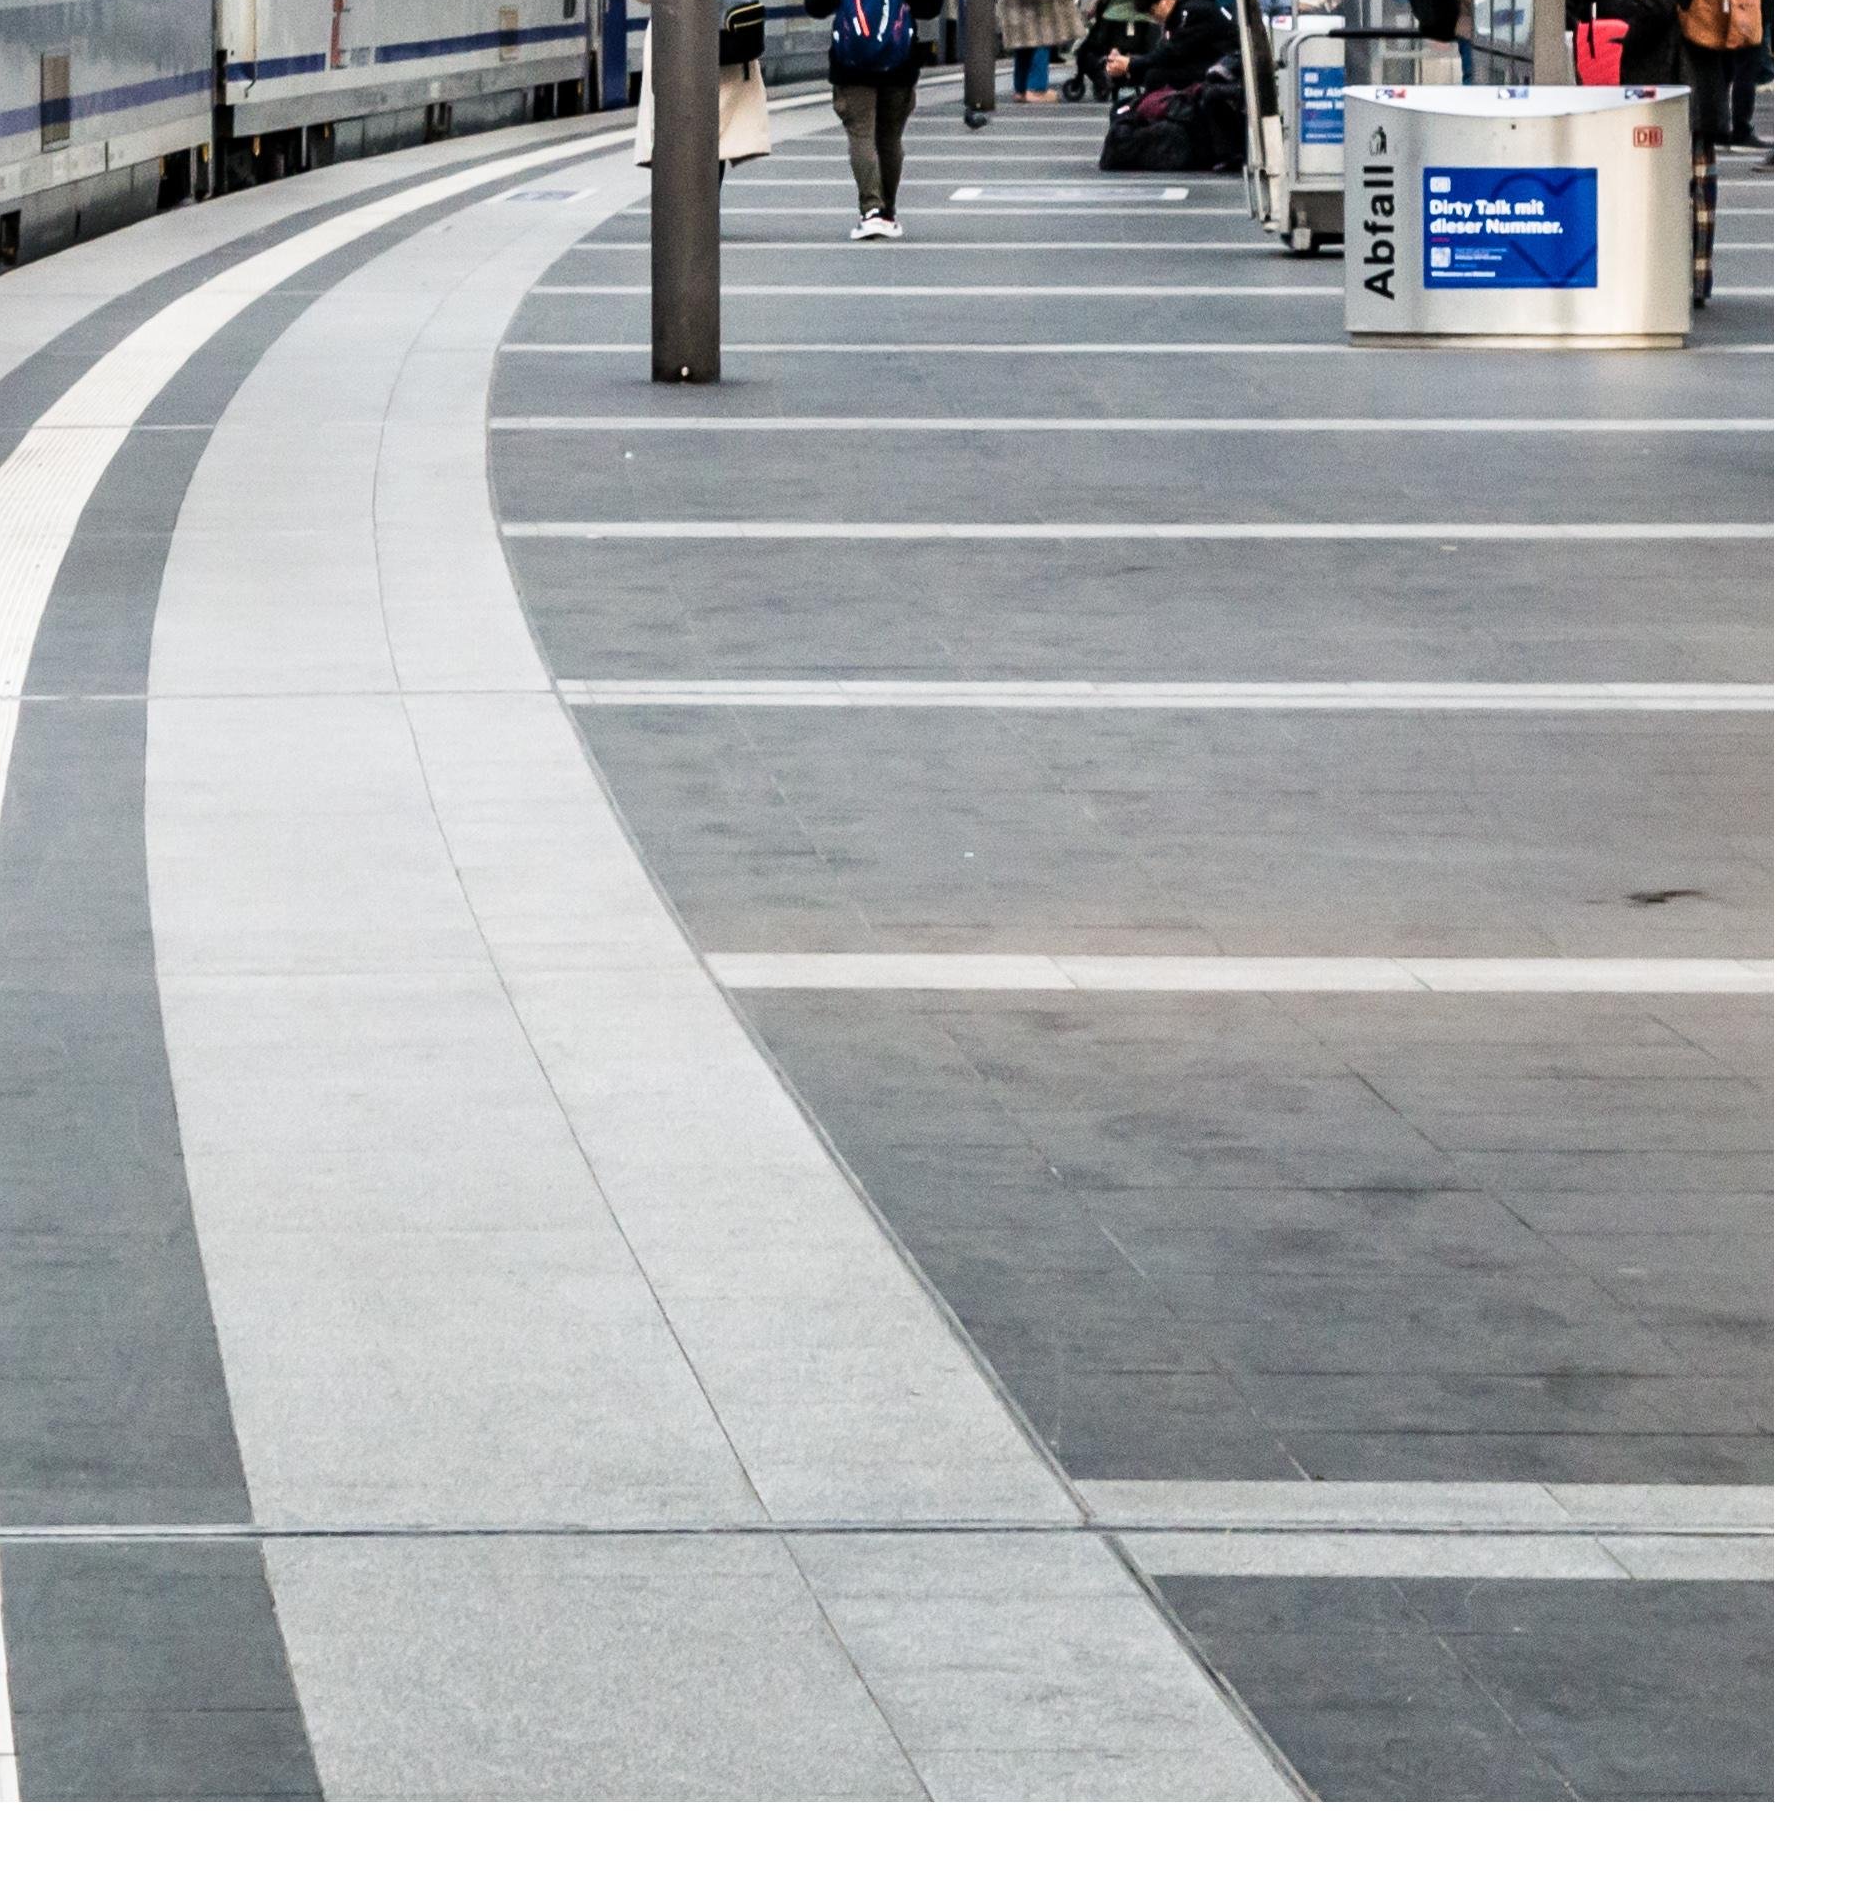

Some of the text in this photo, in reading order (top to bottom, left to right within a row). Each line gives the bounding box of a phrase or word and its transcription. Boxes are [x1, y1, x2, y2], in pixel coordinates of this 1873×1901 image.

[1430, 199, 1544, 218] Dirty Talk mit
[1363, 165, 1395, 300] Abfall
[1430, 218, 1563, 234] dieser Nummer.
